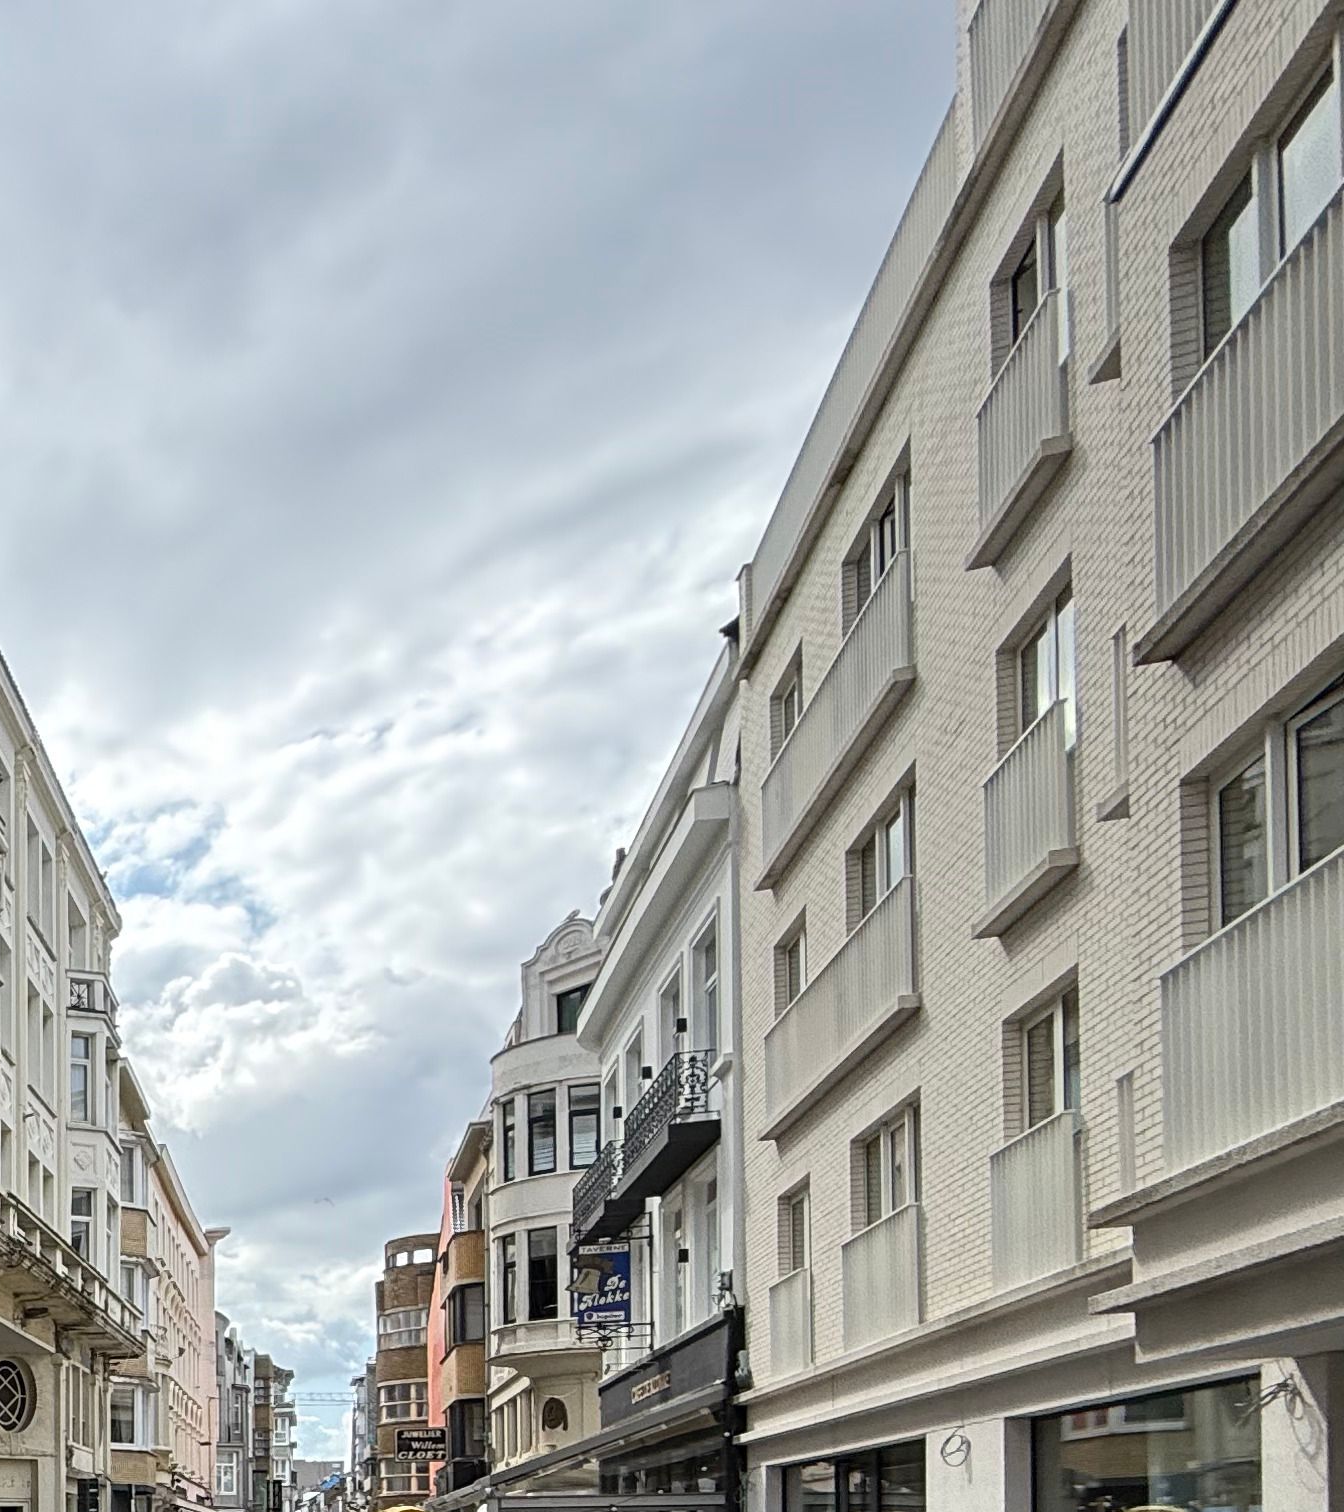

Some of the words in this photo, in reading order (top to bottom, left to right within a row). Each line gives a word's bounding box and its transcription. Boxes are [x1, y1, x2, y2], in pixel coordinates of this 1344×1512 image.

[581, 1244, 627, 1252] TAVERNE
[604, 1274, 627, 1291] De
[400, 1430, 442, 1438] JUWELIER
[411, 1440, 445, 1449] Willem
[398, 1450, 446, 1460] CLOET
